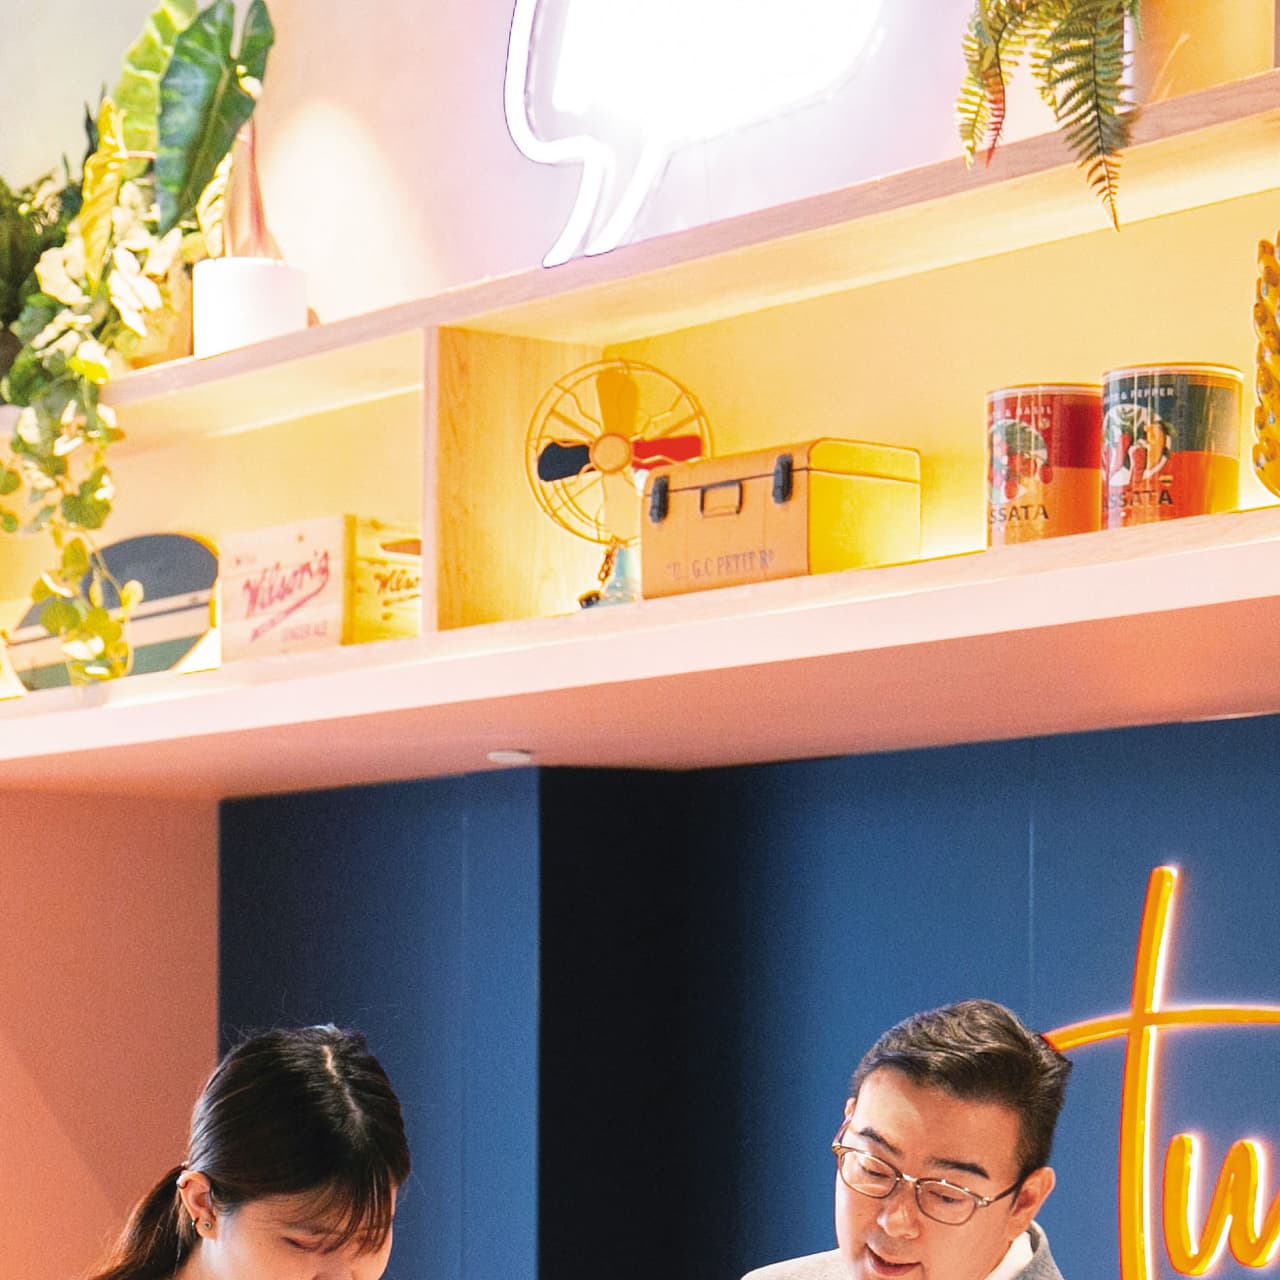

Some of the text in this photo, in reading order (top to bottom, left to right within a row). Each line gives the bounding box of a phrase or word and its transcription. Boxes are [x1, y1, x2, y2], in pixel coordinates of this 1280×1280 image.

[1130, 388, 1174, 399] PEPPER
[1016, 406, 1052, 417] BASIL
[242, 549, 330, 619] Wilson's
